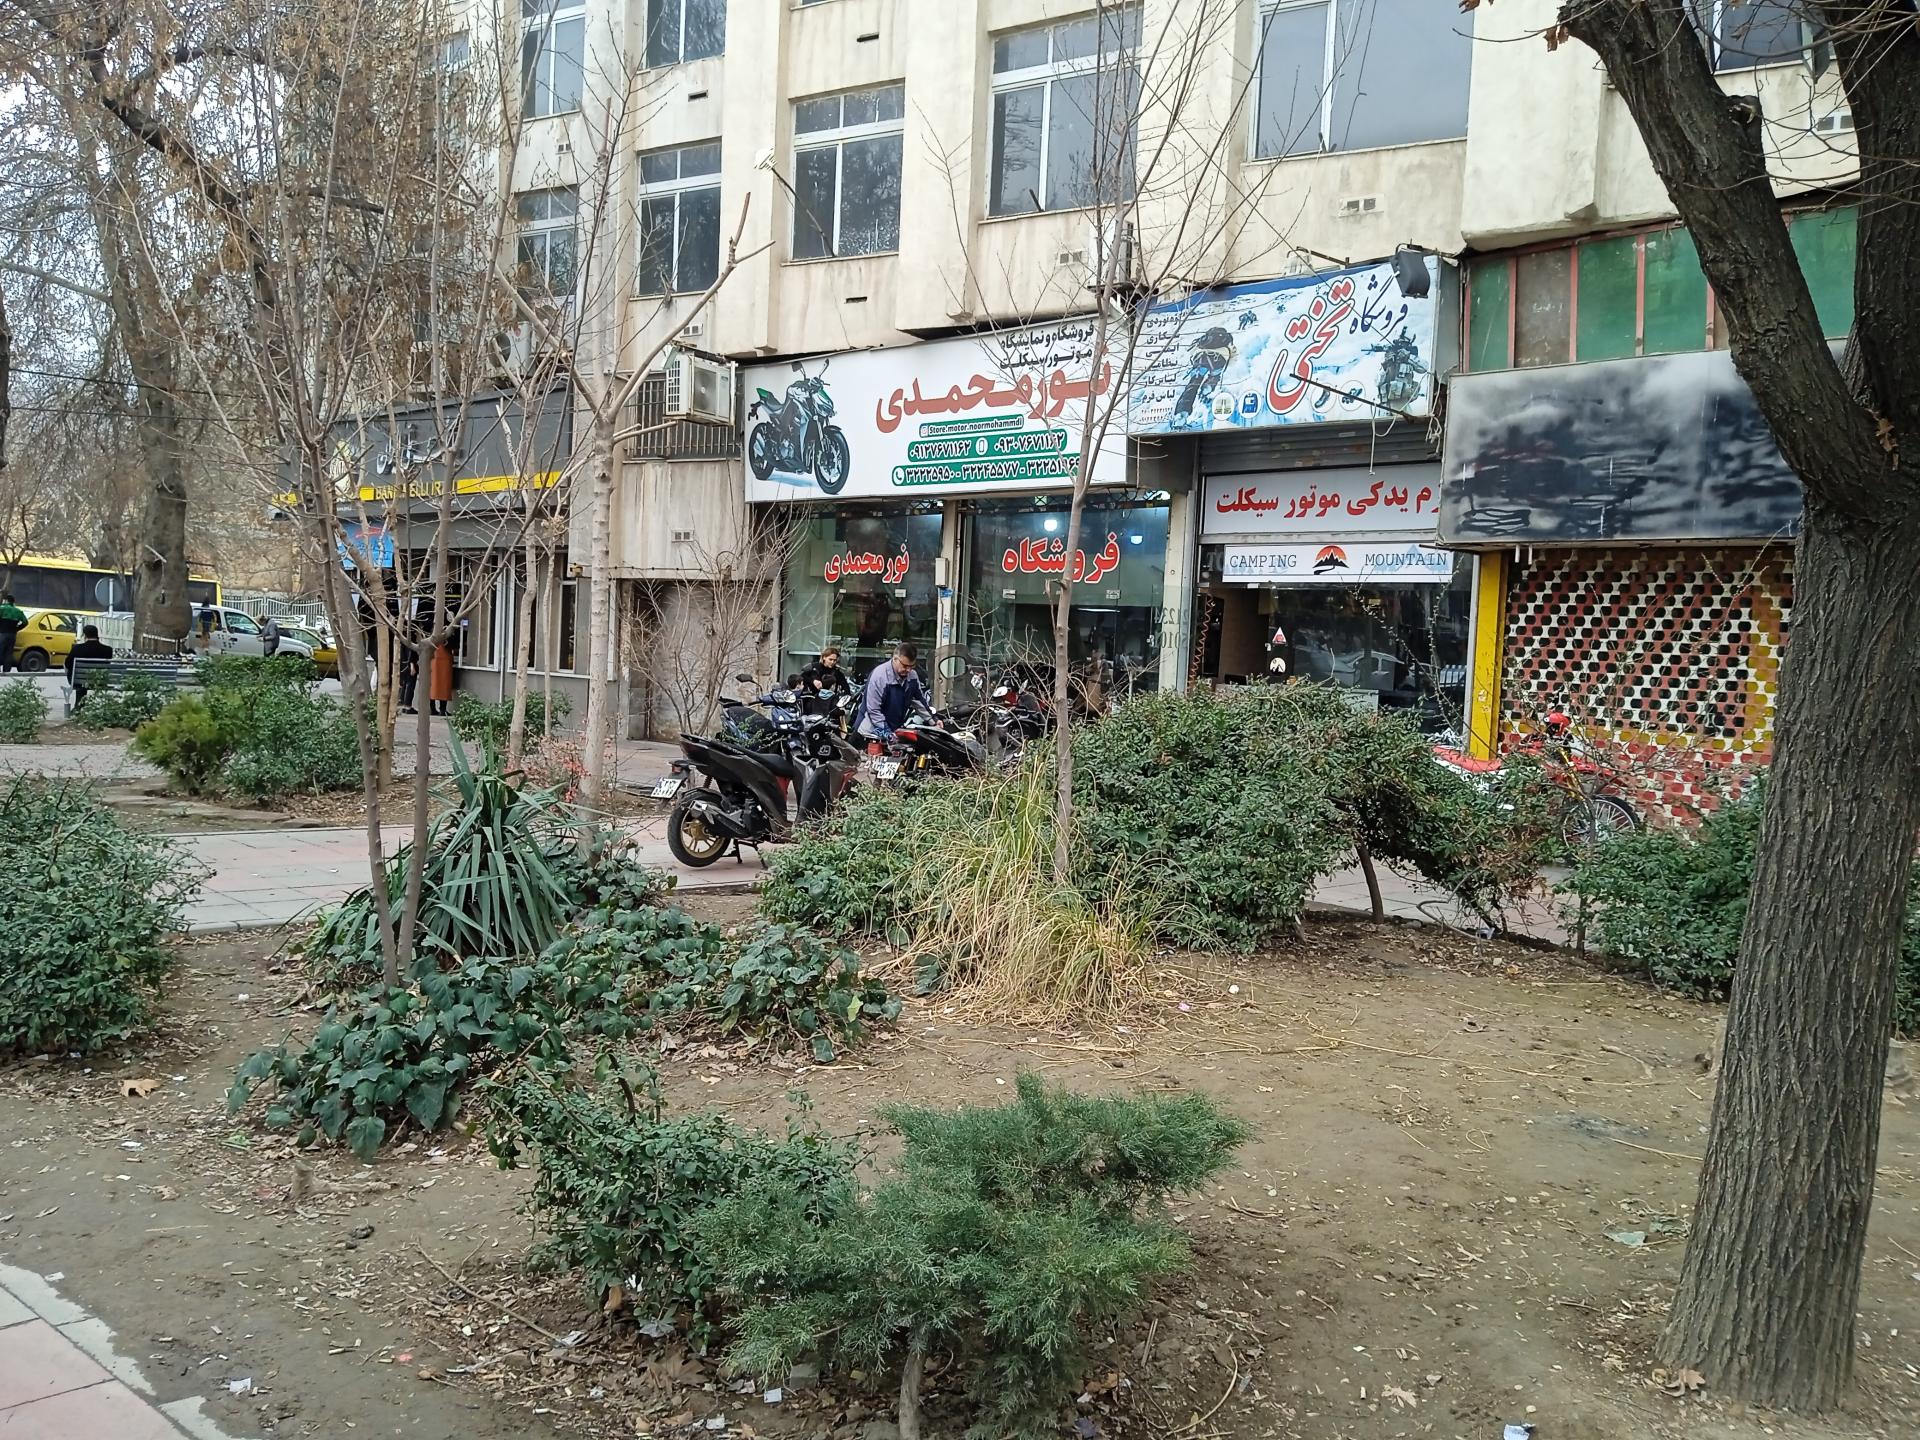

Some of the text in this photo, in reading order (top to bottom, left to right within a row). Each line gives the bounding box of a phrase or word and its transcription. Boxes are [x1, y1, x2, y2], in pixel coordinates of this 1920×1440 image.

[1350, 273, 1409, 342] فروشگاه
[1043, 333, 1051, 348] و
[1052, 319, 1095, 343] فروشگاه
[1266, 276, 1356, 415] تختی
[1216, 487, 1278, 518] سیکلت
[1284, 485, 1340, 518] موتور
[1347, 480, 1408, 515] یدکی
[1002, 531, 1120, 583] فروشگاه
[1229, 553, 1297, 569] CAMPING
[1364, 552, 1447, 567] MOUNTAIN
